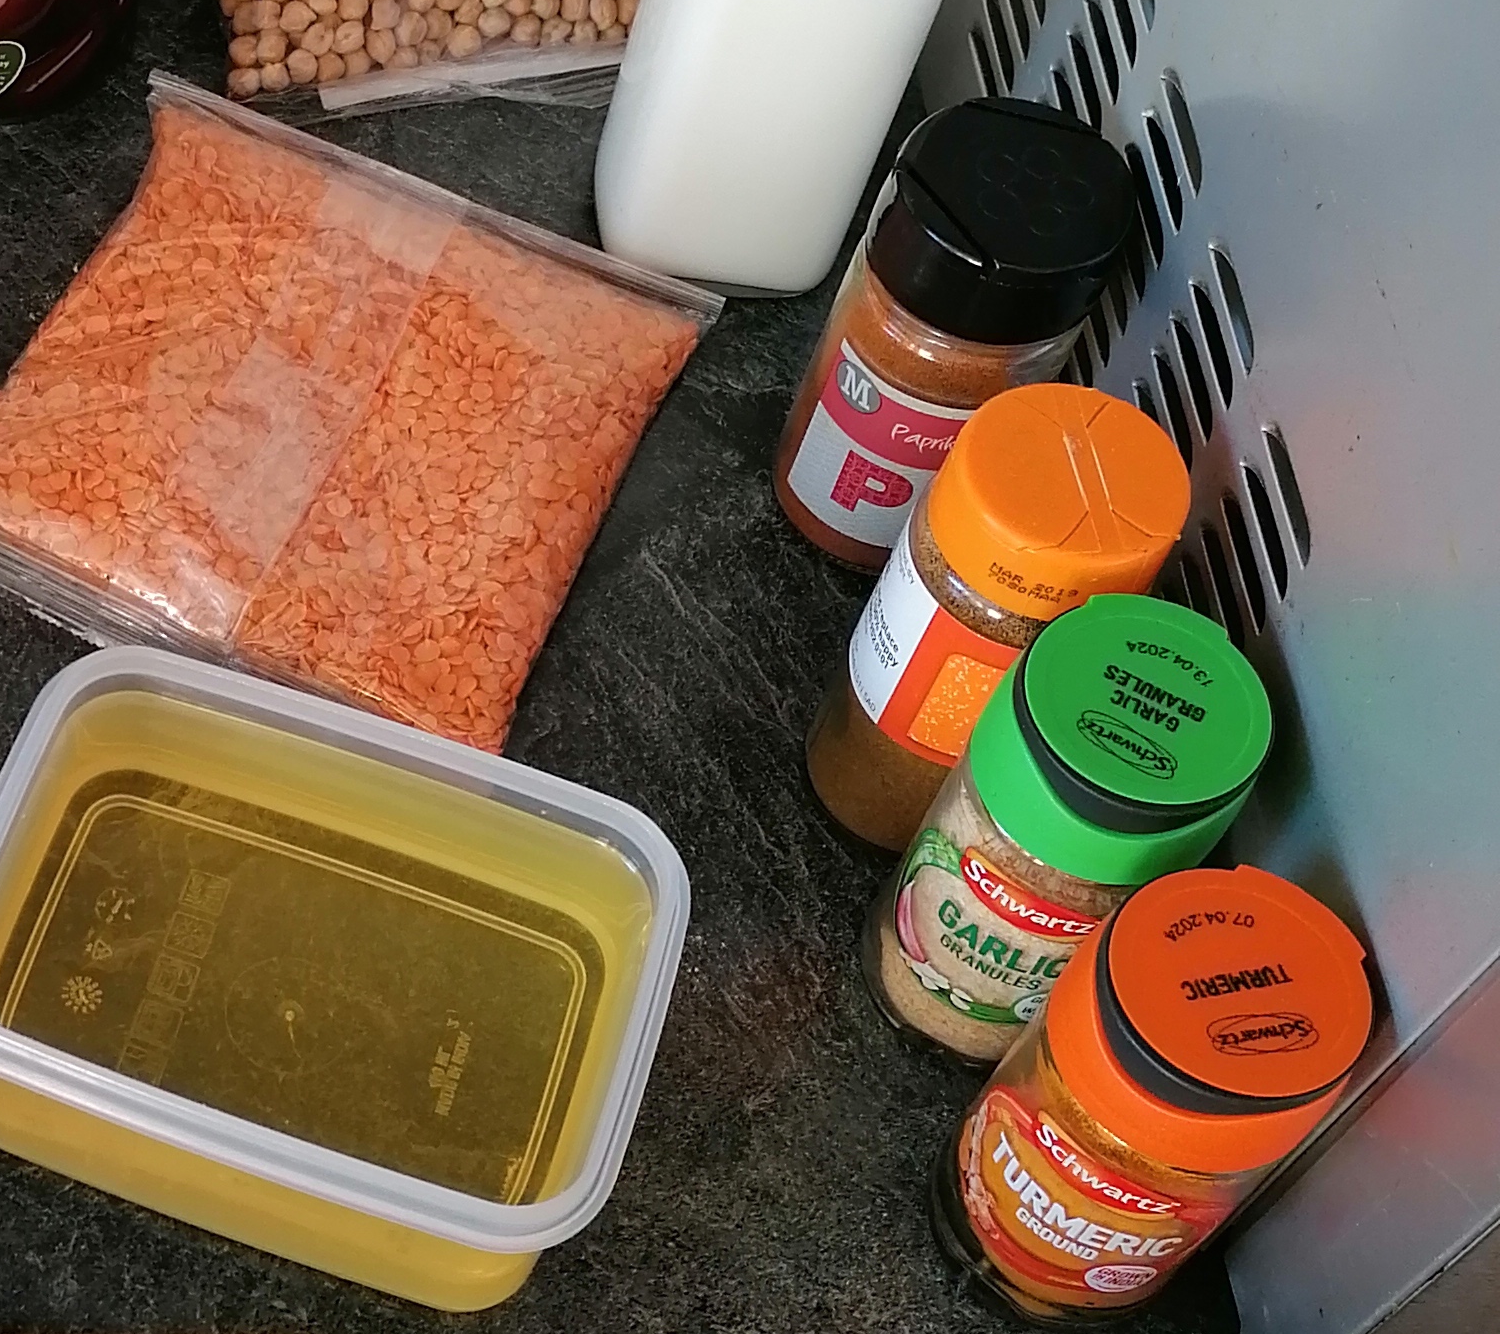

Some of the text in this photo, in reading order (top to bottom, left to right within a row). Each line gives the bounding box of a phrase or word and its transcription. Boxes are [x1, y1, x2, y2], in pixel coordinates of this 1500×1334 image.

[840, 365, 872, 411] M
[890, 423, 957, 454] Paprik
[830, 449, 914, 513] P
[989, 562, 1024, 584] MAR
[878, 628, 899, 668] happy
[1103, 664, 1207, 723] GRANULES
[1110, 689, 1180, 733] GARLIC
[1086, 721, 1171, 771] Schwartz
[964, 858, 1097, 934] Schwartz
[1163, 910, 1255, 942] 07.04.2024
[940, 933, 1042, 991] GRANULES
[1180, 963, 1294, 1001] TURMERIC
[1217, 1019, 1314, 1046] Schwartz
[1035, 1124, 1173, 1214] Schwartz
[992, 1131, 1183, 1257] TURMERIC
[1015, 1207, 1099, 1261] GROUND
[1098, 1267, 1153, 1281] GROWN
